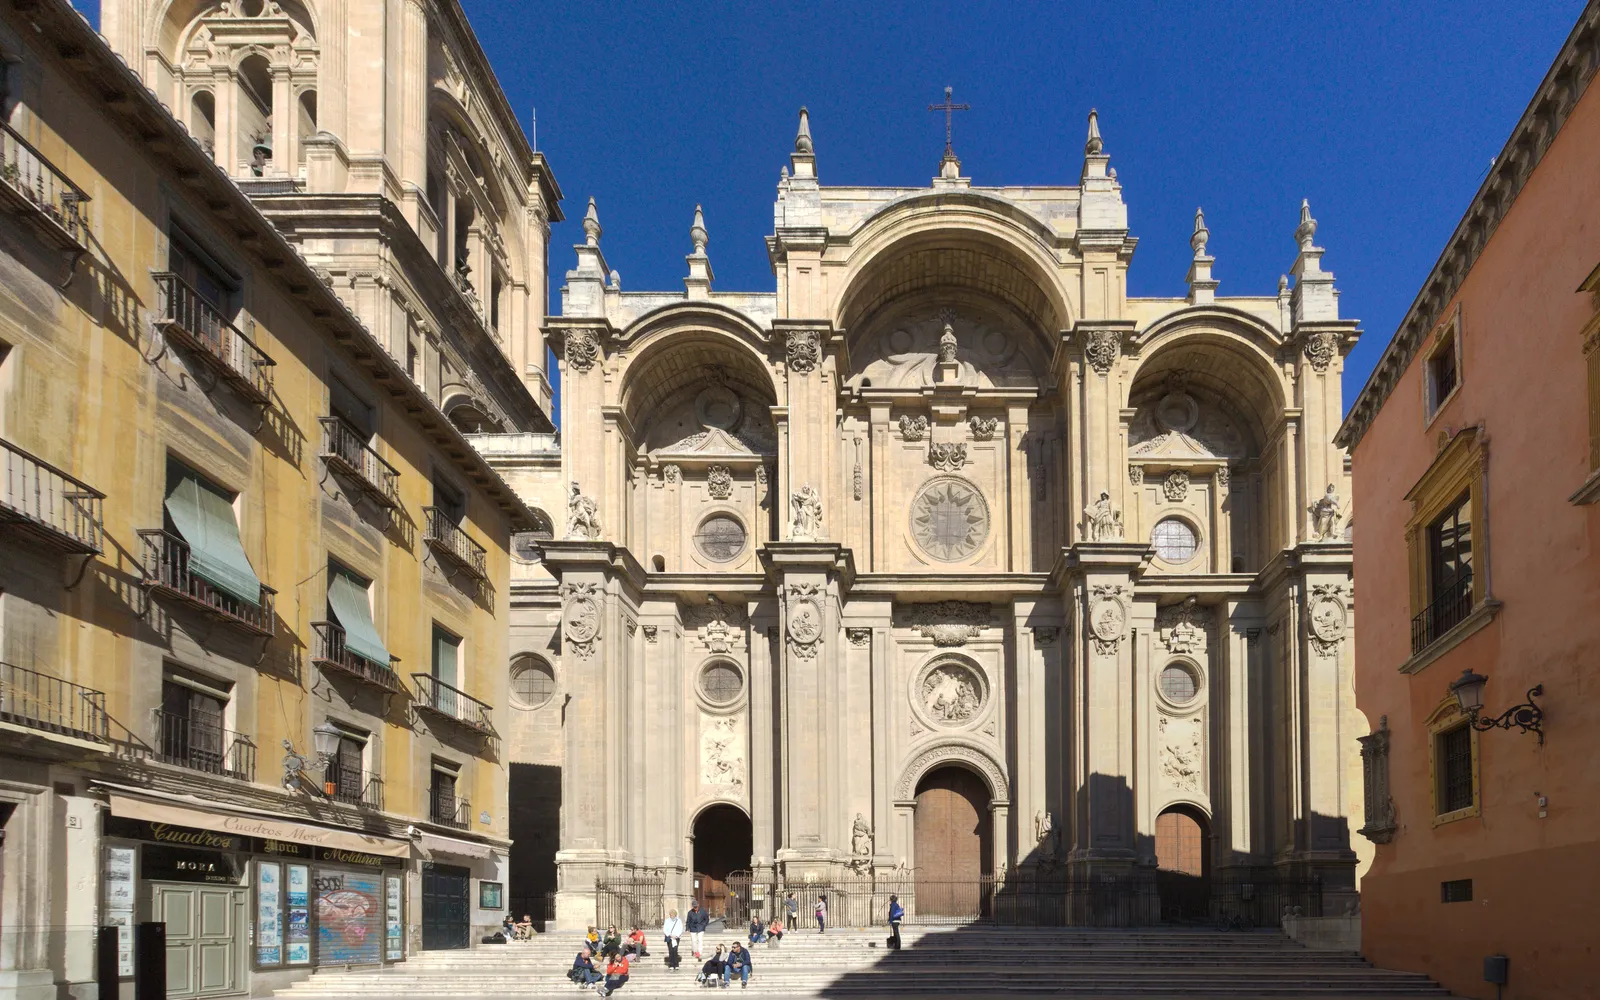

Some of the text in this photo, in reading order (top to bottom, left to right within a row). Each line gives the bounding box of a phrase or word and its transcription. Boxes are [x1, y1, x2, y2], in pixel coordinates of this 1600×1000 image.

[223, 817, 323, 843] Cuadros Mora
[150, 821, 233, 848] Cuadros
[323, 848, 381, 866] Molduras
[176, 860, 216, 872] MORA
